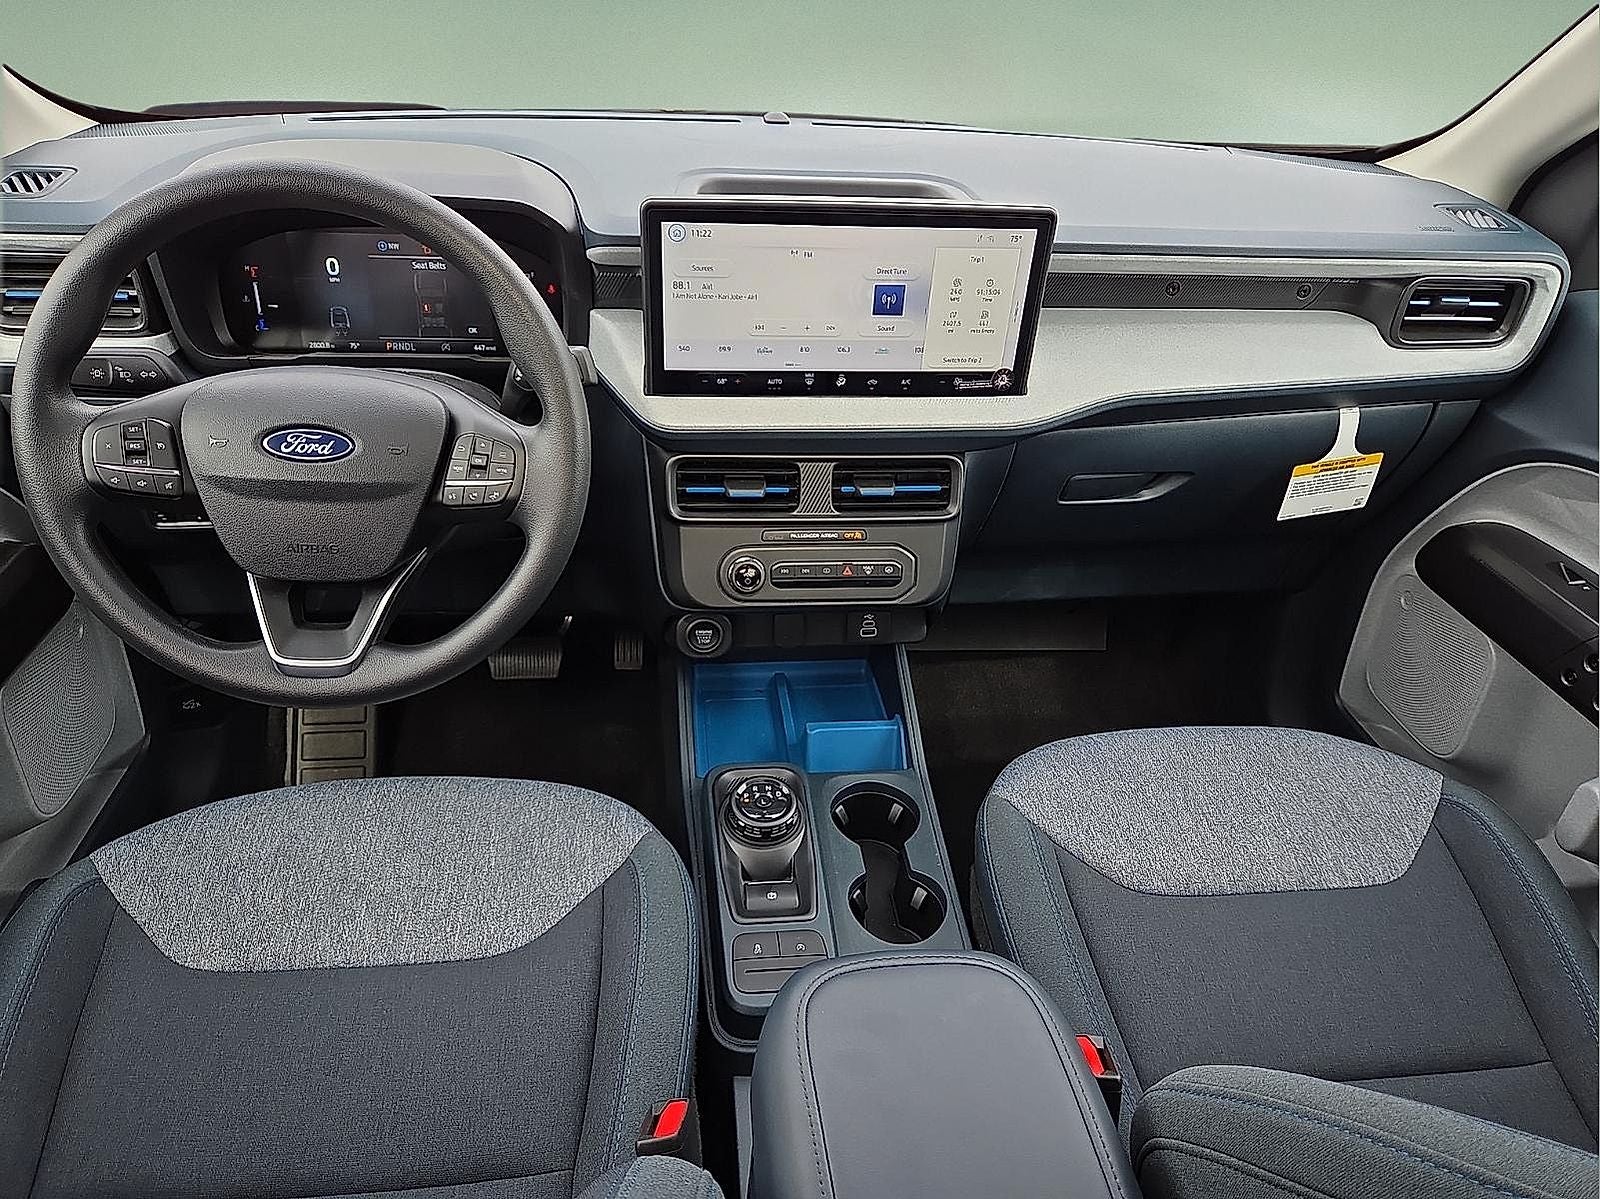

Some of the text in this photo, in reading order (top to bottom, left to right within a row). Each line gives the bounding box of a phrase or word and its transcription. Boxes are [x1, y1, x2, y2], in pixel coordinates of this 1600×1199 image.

[690, 229, 712, 238] 11:22
[1010, 235, 1023, 243] 75°
[325, 257, 340, 276] 0
[411, 261, 447, 270] Seat Belts
[672, 281, 691, 290] 88.1
[280, 432, 335, 456] Ford
[284, 542, 340, 554] AIRBAG
